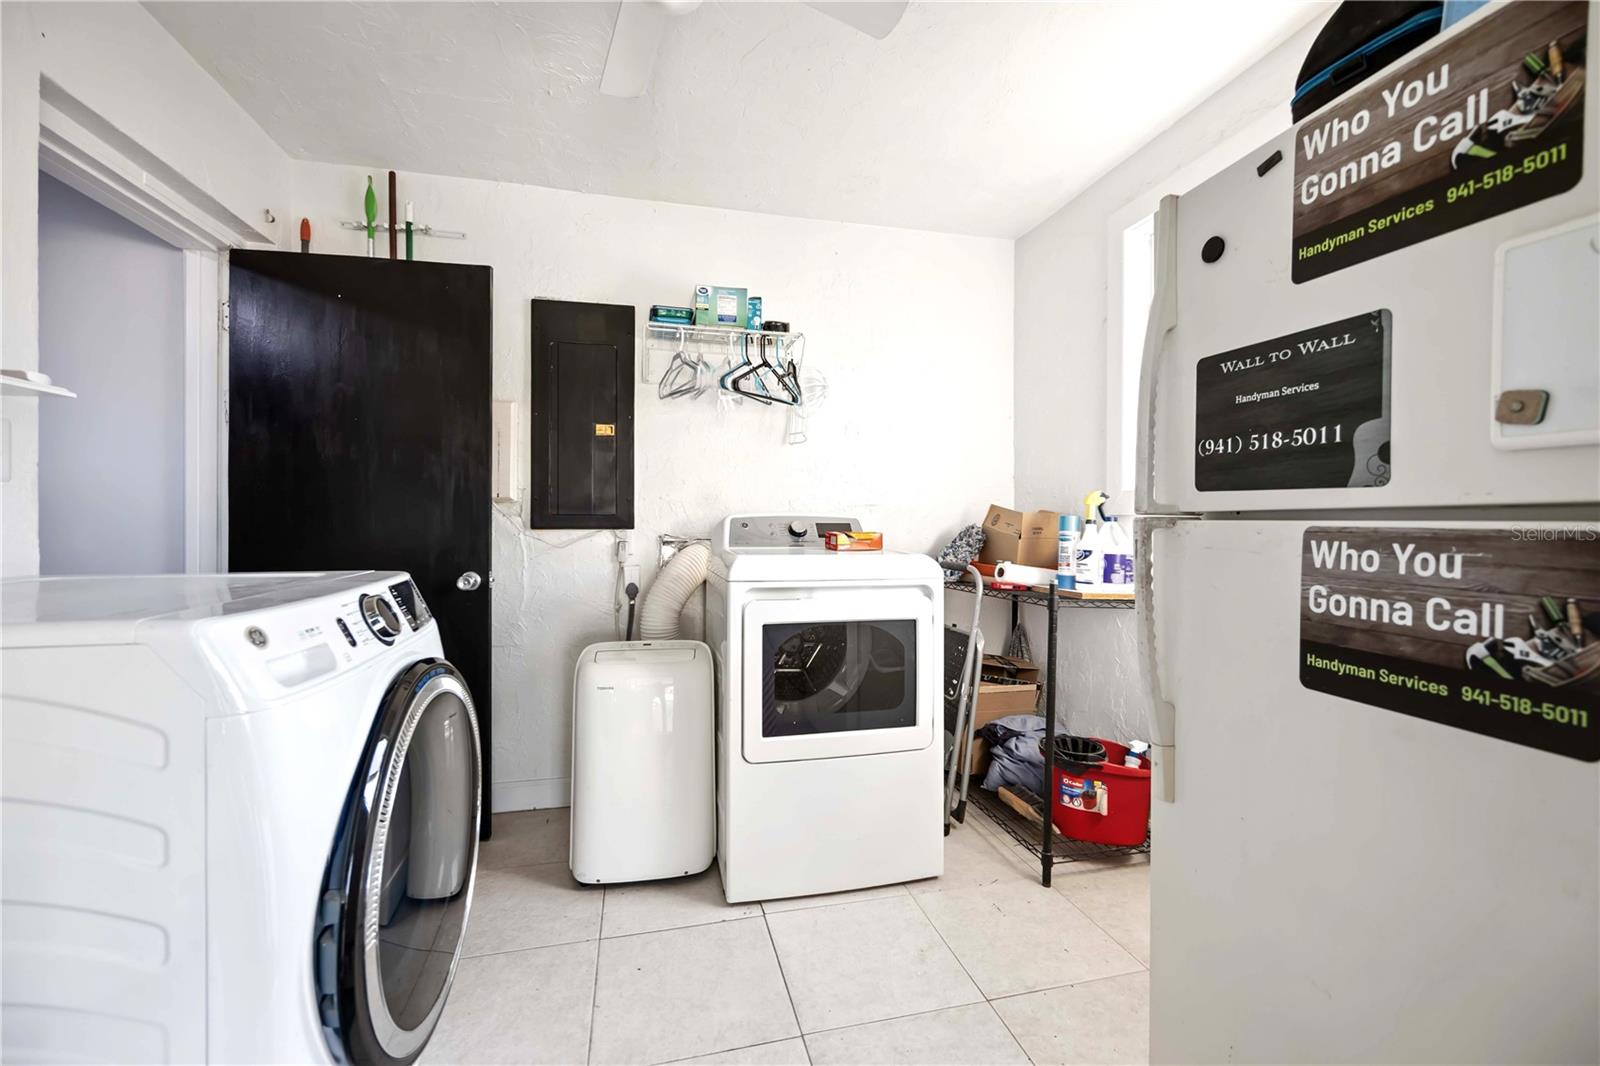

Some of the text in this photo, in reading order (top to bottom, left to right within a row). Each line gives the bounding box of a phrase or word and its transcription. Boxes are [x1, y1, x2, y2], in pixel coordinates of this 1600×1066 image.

[1303, 63, 1450, 161] Who You
[1300, 88, 1489, 206] Gonna Call
[1298, 144, 1568, 260] Handyman Services 941-518-5011
[1220, 357, 1265, 373] WALL
[1297, 333, 1357, 355] WALL
[1235, 381, 1320, 404] Handyman Services
[1198, 424, 1342, 457] (941) 518-5011
[1310, 540, 1463, 579] Who You
[1308, 585, 1504, 639] Gonna Call
[1306, 653, 1588, 728] Handyman Services 941-518-5011
